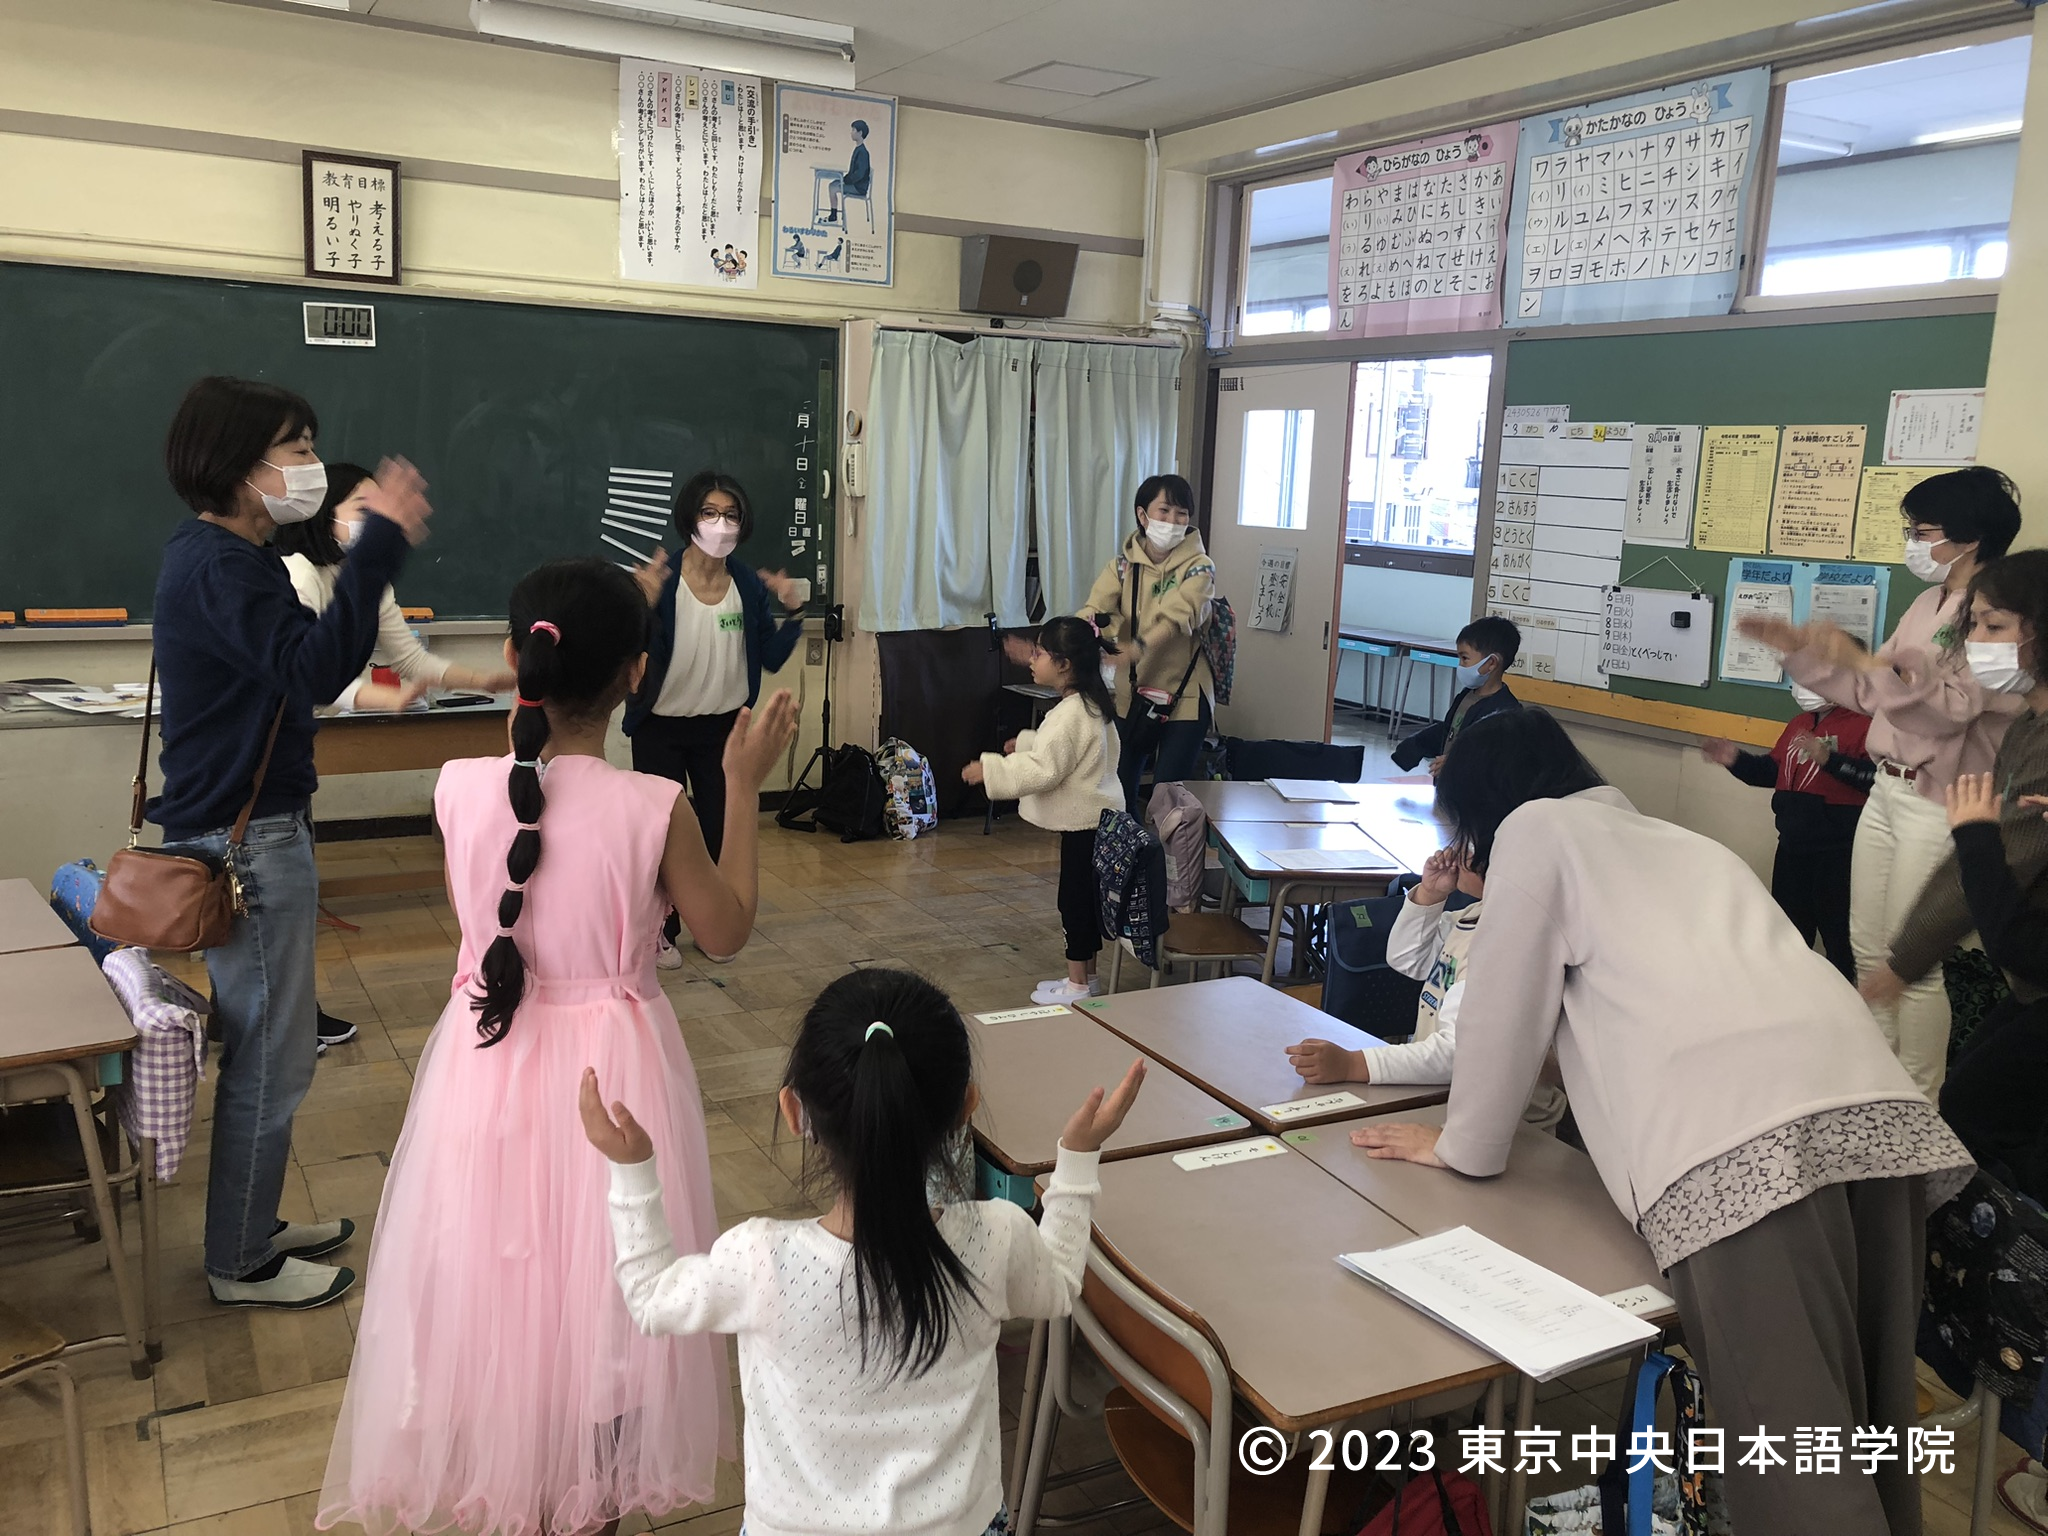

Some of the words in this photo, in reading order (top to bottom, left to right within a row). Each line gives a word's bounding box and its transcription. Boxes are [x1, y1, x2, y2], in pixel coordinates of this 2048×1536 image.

[1585, 111, 1646, 135] かたかなの
[1655, 101, 1687, 121] ひょう
[1383, 153, 1430, 172] ひらがなの
[1436, 145, 1461, 162] ひょう
[322, 170, 386, 192] 教育目標
[323, 196, 340, 268] 明るい子
[347, 199, 362, 269] やりぬく子
[369, 200, 387, 271] 考える子
[1525, 425, 1539, 433] がつ
[1549, 424, 1559, 433] 10
[1570, 427, 1584, 436] にち
[1606, 426, 1627, 436] ようび
[1792, 435, 1854, 443] 休み時間のすごし方
[1501, 473, 1507, 485] 1
[1509, 472, 1538, 488] こくご
[1496, 501, 1505, 514] 2
[1508, 500, 1537, 517] さんすう
[1493, 526, 1502, 539] 3
[1503, 527, 1532, 545] どうとく
[1261, 559, 1291, 569] 今週の目標
[1491, 557, 1499, 569] 4
[1503, 553, 1531, 569] おんがく
[1742, 568, 1791, 583] 学年だより
[1815, 572, 1873, 585] 学校だより
[1254, 574, 1266, 627] しましょう
[1487, 586, 1496, 598] 5
[1501, 584, 1530, 602] こくご
[1535, 661, 1552, 674] そと
